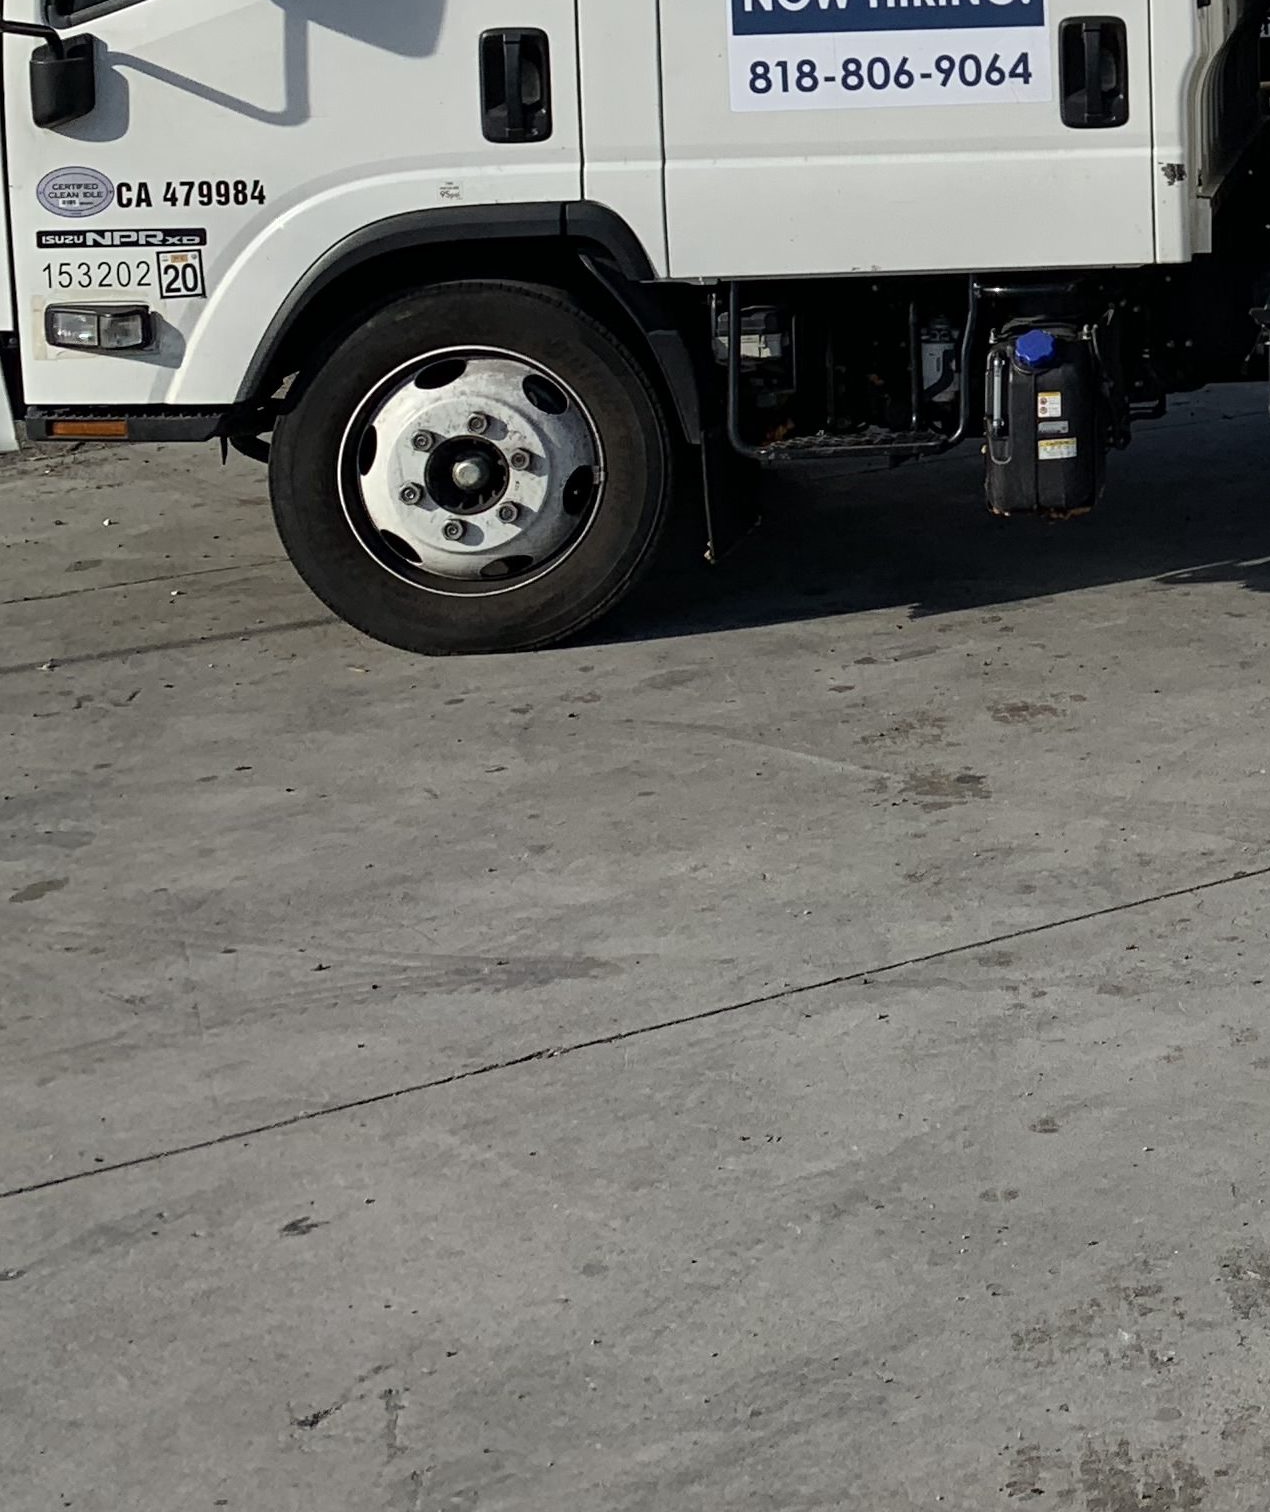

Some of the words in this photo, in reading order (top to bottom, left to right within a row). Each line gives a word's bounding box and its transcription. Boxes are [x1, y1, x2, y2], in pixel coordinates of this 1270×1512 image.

[749, 52, 1032, 94] 818-806-9064
[48, 191, 79, 199] CLEAN
[82, 191, 103, 199] IDLE
[52, 183, 99, 191] CERTIFIED
[116, 181, 153, 208] CA
[163, 180, 266, 207] 479984
[42, 235, 84, 244] ISUZU
[85, 231, 163, 246] NPR
[165, 236, 200, 245] XD
[42, 261, 152, 289] 153202
[163, 263, 199, 294] 20
